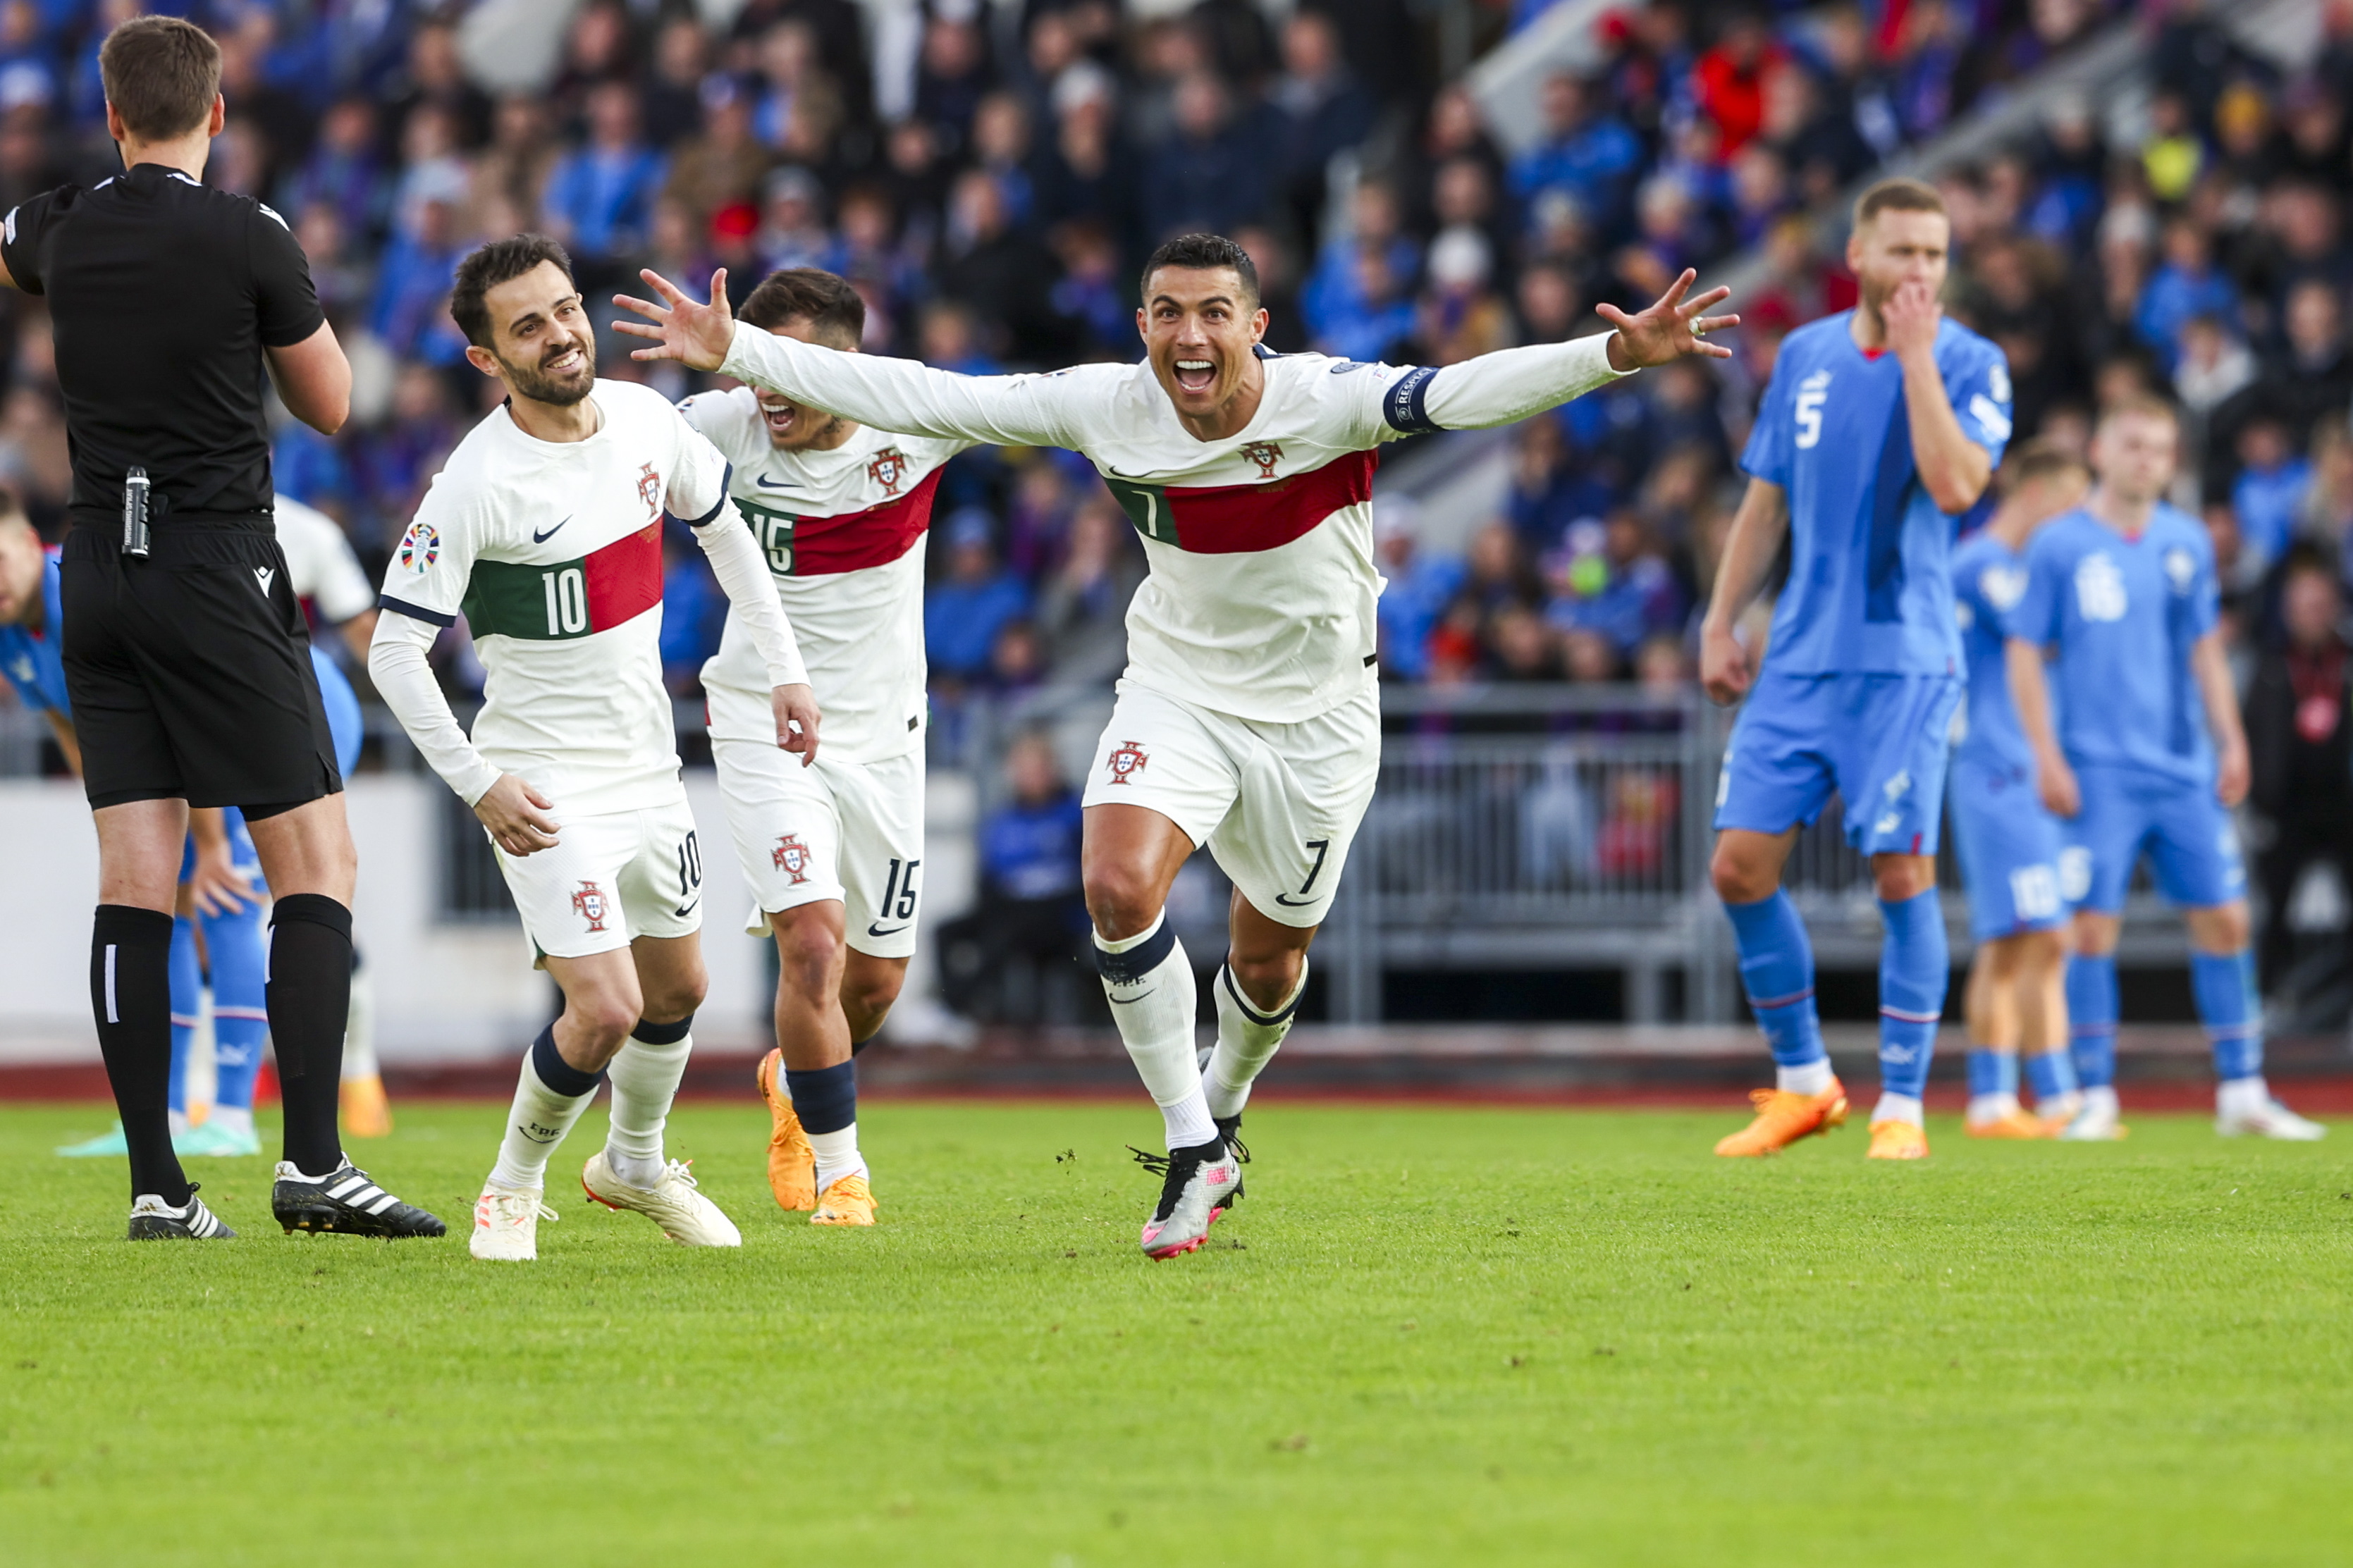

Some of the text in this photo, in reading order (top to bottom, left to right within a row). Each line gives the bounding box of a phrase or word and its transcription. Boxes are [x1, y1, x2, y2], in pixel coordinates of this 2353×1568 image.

[1794, 391, 1828, 450] 5
[752, 513, 793, 572] 15
[1130, 490, 1158, 538] 7
[541, 567, 586, 636] 10
[677, 829, 702, 897] 10
[880, 858, 921, 920] 15
[1298, 839, 1329, 895] 7
